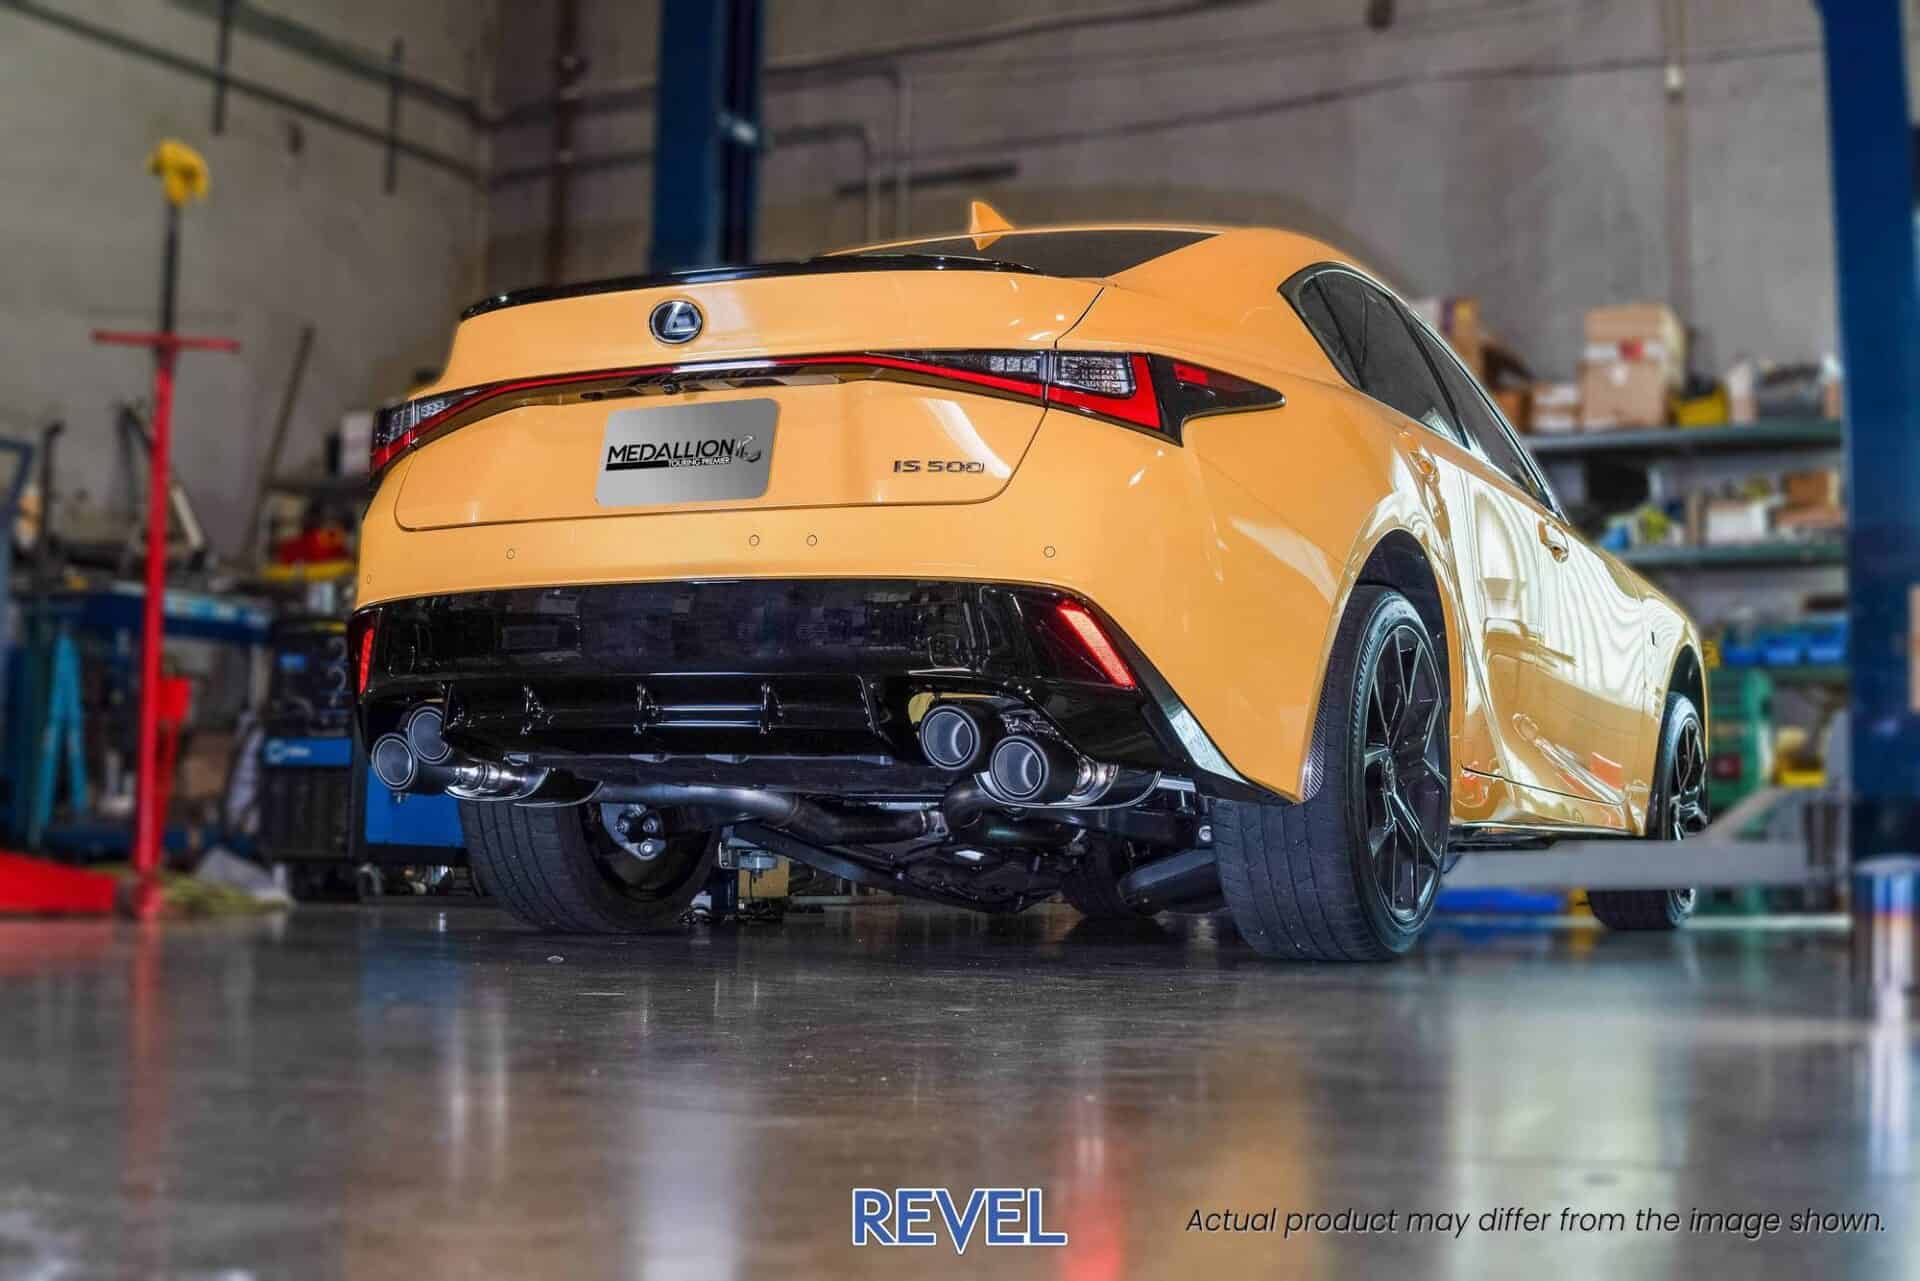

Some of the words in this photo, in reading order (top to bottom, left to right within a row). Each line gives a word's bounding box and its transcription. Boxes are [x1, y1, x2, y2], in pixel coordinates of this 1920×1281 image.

[607, 438, 736, 463] MEDALLION
[893, 460, 921, 473] IS
[927, 460, 985, 474] 500
